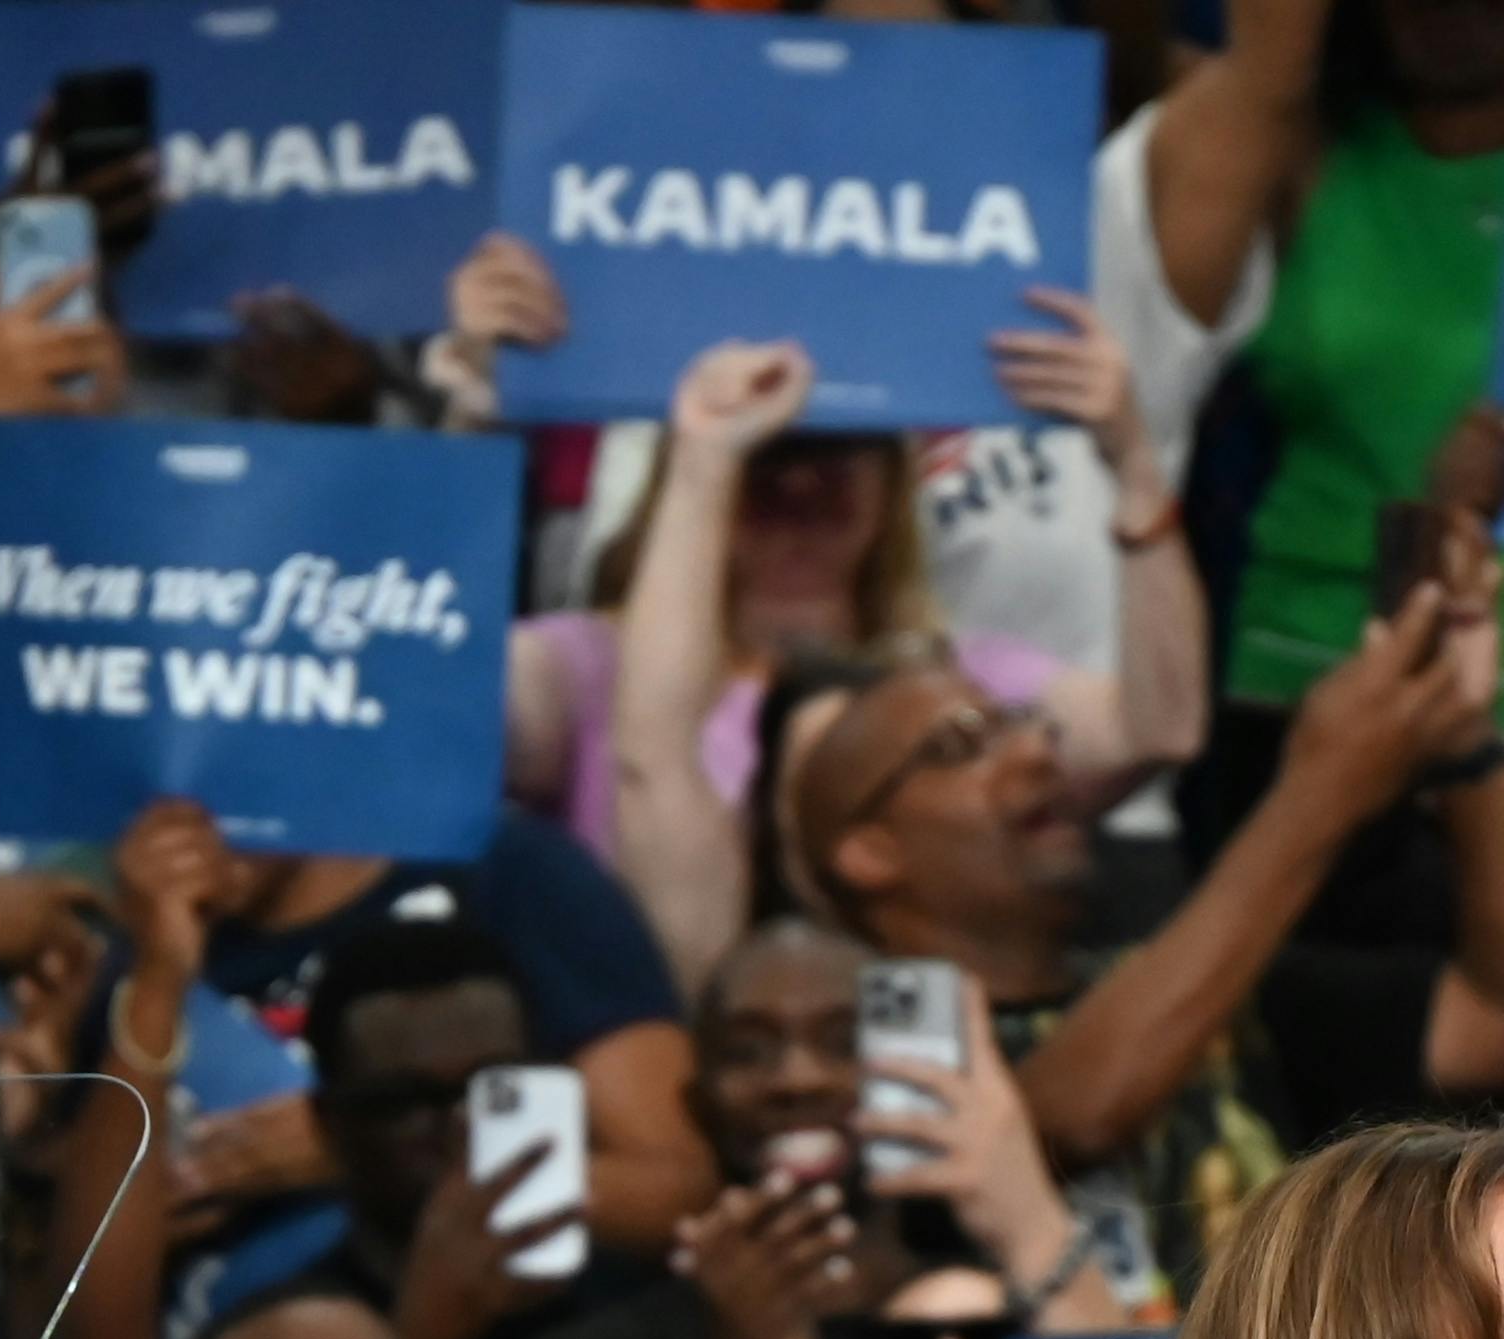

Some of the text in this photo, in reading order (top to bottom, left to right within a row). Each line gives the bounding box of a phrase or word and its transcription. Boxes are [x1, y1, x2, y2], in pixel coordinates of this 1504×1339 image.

[6, 117, 474, 201] MALA
[551, 165, 1039, 268] KAMALA
[149, 576, 253, 626] we
[244, 552, 467, 651] fight,
[24, 647, 382, 725] WE WIN.
